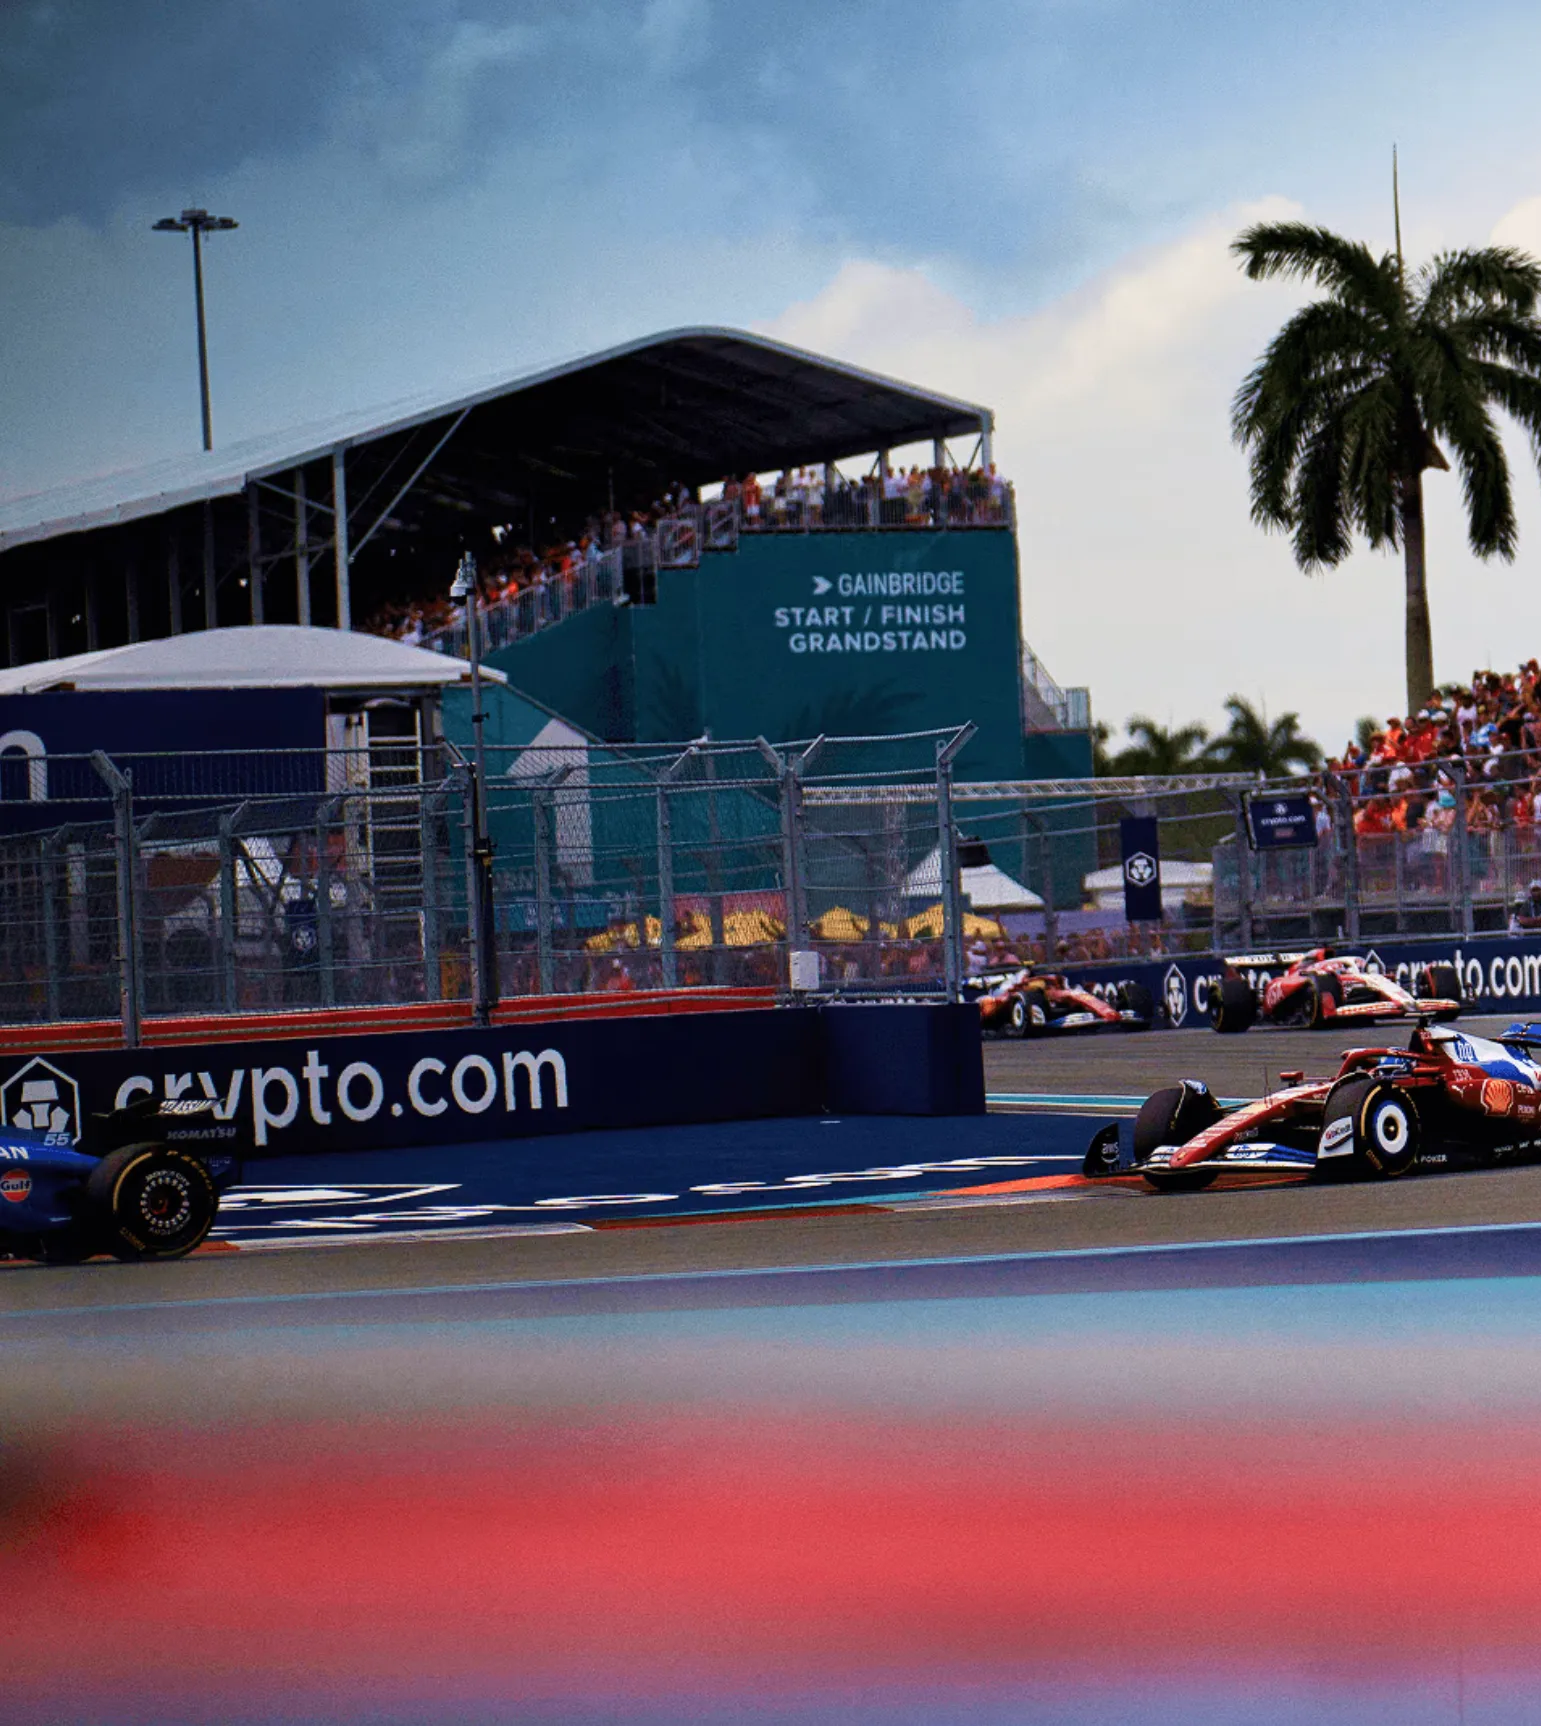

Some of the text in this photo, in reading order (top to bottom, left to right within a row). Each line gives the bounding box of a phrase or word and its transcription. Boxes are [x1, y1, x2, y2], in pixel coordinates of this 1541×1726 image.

[838, 571, 965, 595] GAINBRIDGE
[774, 604, 965, 628] START / FINISH
[789, 630, 966, 652] GRANDSTAND
[114, 1048, 569, 1146] crypto.com
[44, 1133, 70, 1146] 55
[167, 1126, 237, 1140] KOMATSU
[1, 1180, 31, 1192] Gulf
